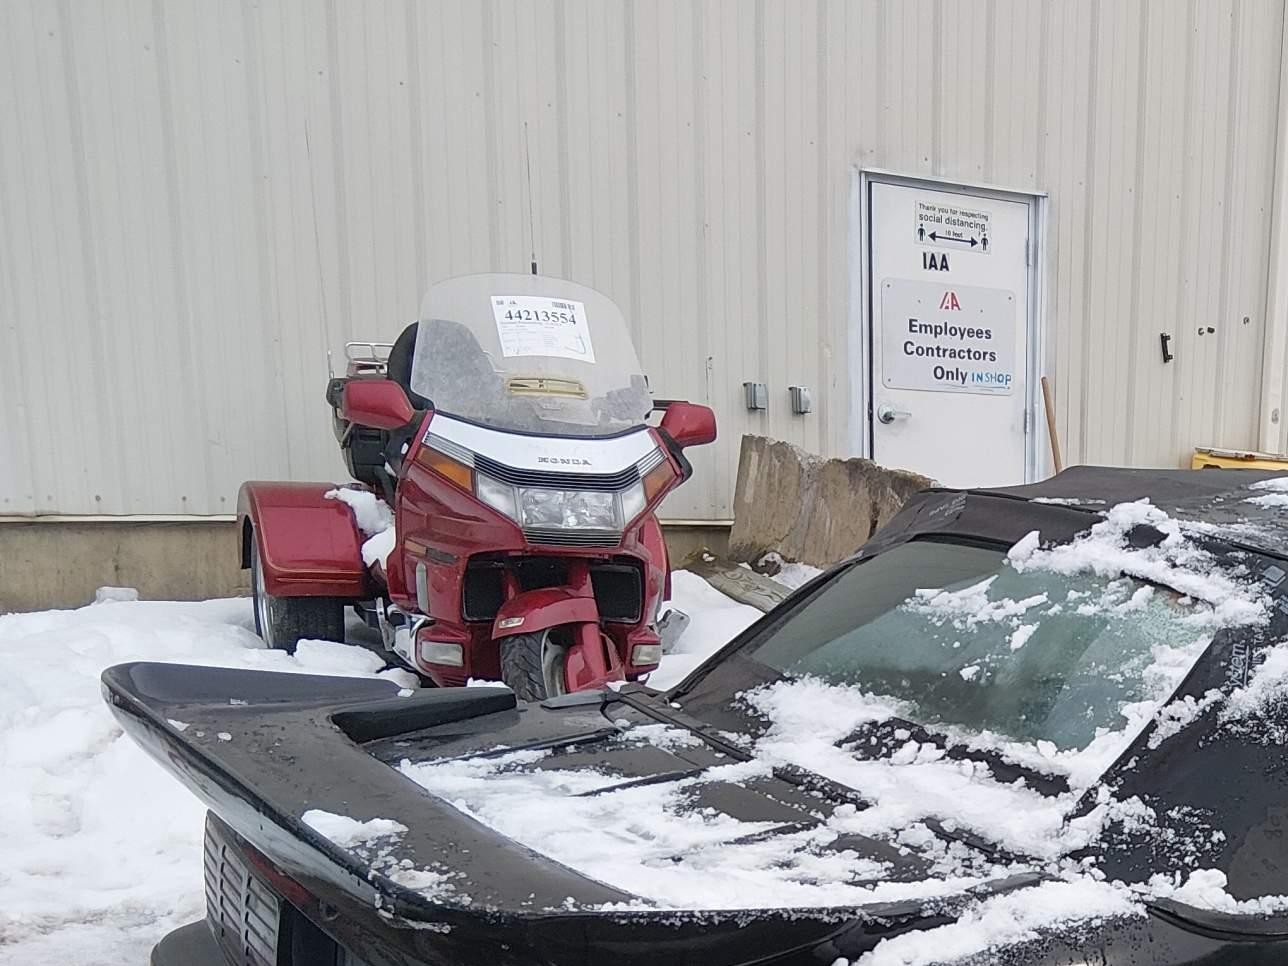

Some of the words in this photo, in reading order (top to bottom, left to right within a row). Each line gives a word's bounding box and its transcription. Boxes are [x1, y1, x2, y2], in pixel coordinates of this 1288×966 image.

[918, 202, 936, 211] Thank
[938, 206, 949, 214] you
[959, 210, 989, 222] respecting
[918, 213, 943, 224] social
[922, 252, 950, 272] IAA
[505, 309, 576, 325] 44213554
[908, 318, 992, 340] Employees
[903, 341, 997, 361] Contractors
[933, 366, 968, 384] Only
[537, 456, 592, 466] HONDA
